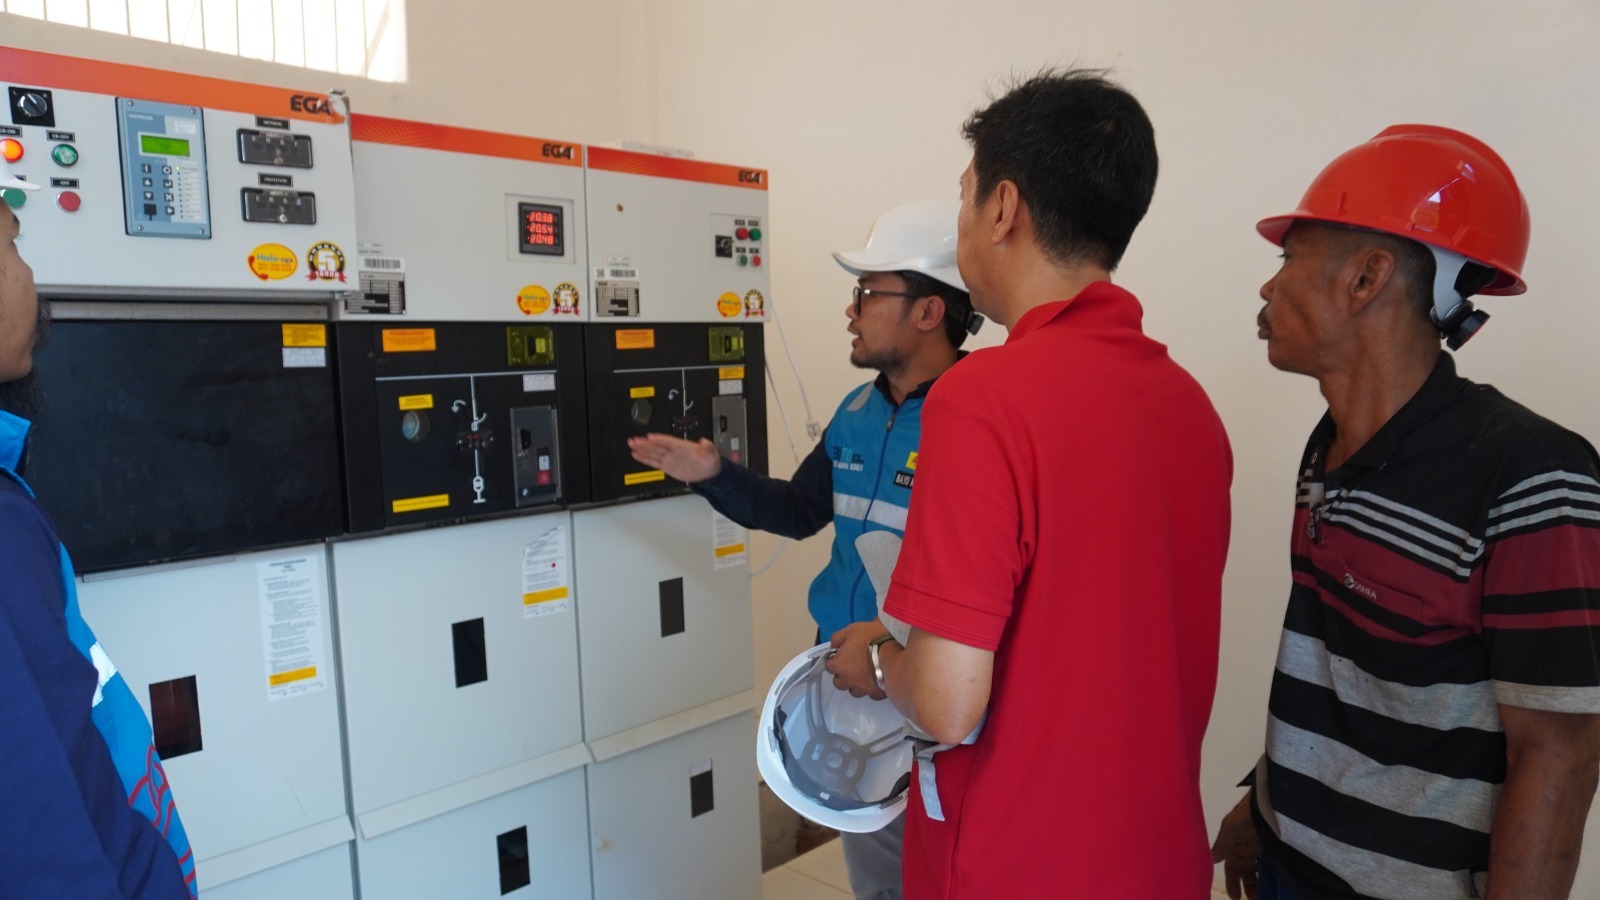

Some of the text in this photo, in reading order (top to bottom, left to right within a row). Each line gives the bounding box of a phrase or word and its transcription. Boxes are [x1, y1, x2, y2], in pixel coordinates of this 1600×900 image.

[289, 94, 332, 115] EGA
[128, 113, 154, 121] SIEMENS
[541, 142, 573, 160] EGA
[738, 169, 761, 185] EGA
[257, 254, 278, 262] Halo
[317, 251, 336, 271] 5
[315, 270, 339, 278] TAHUN
[558, 289, 572, 306] 5
